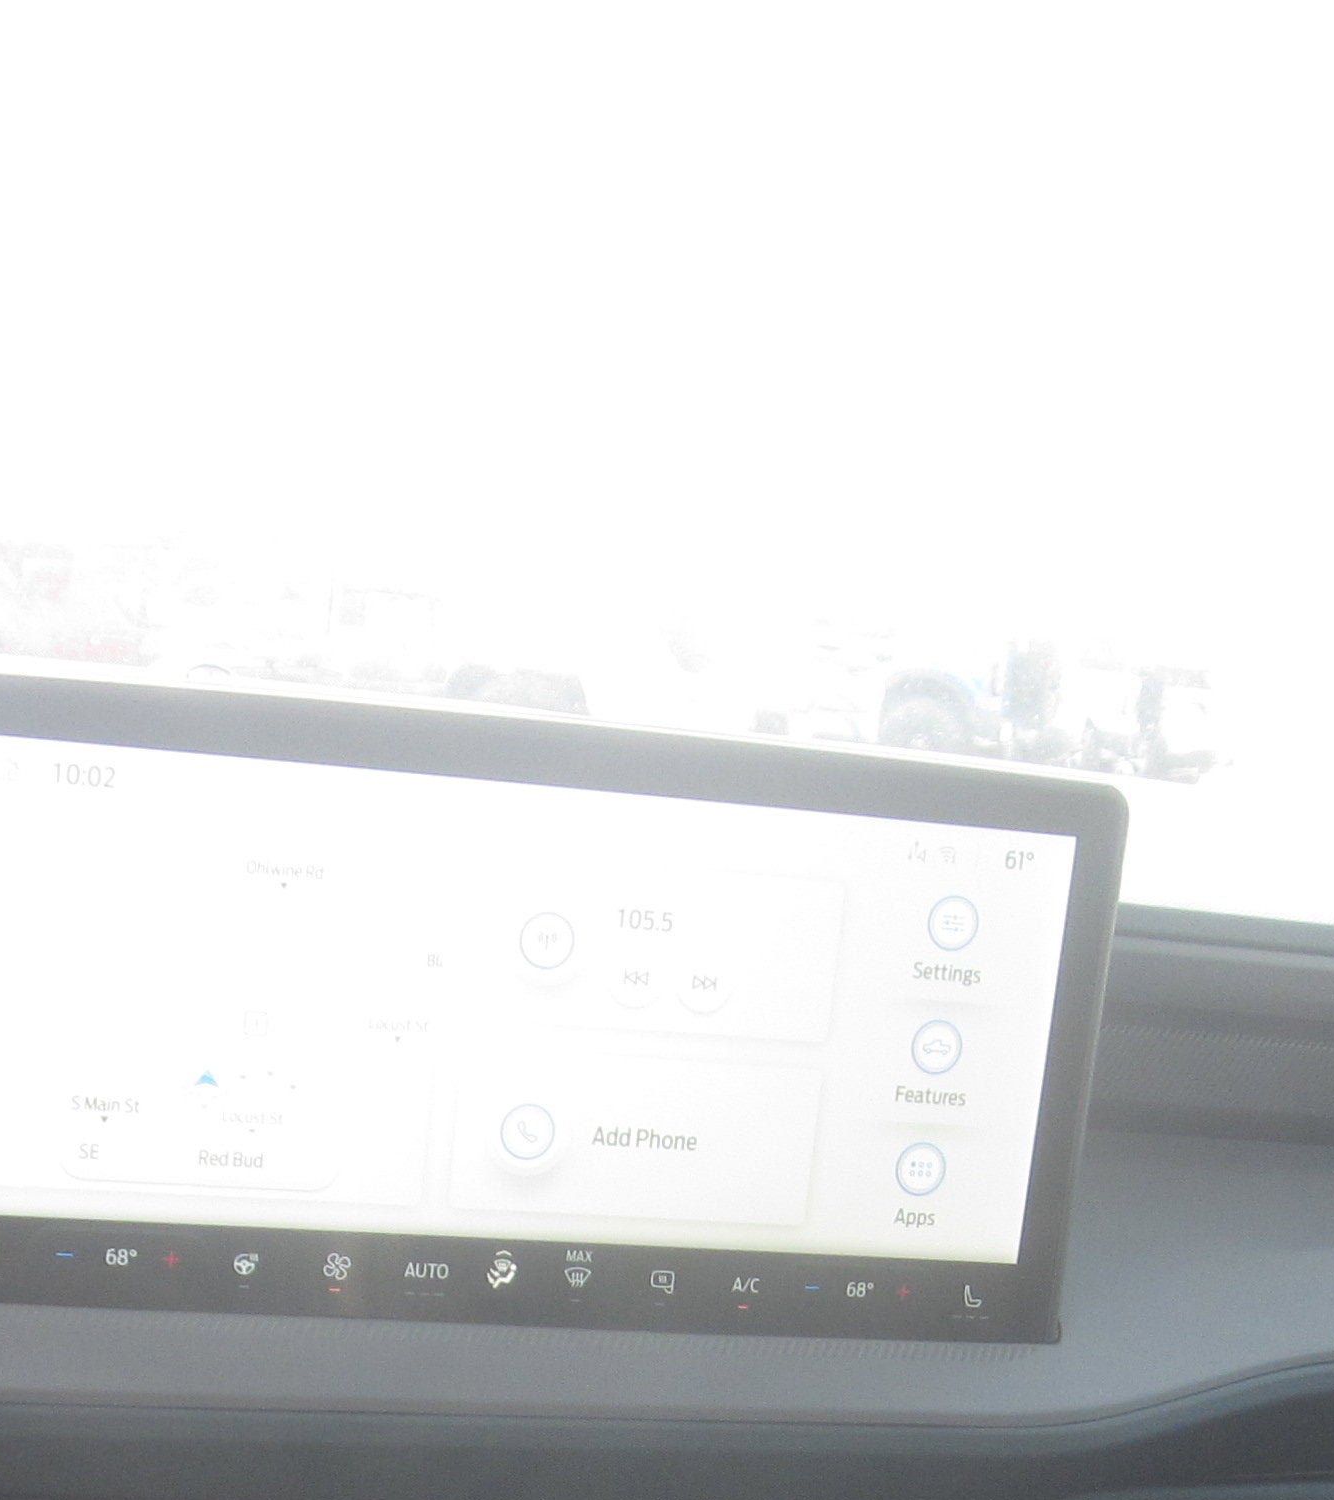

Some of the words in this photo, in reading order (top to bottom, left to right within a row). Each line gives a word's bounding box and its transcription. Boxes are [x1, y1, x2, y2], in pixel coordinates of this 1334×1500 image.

[54, 763, 116, 788] 10:02
[1005, 850, 1034, 870] 61°
[618, 909, 673, 931] 105.5
[912, 961, 981, 986] Settings
[71, 1096, 81, 1110] S
[84, 1097, 120, 1113] Main
[125, 1098, 139, 1113] St
[895, 1085, 966, 1107] Features
[591, 1126, 631, 1147] Add
[636, 1128, 697, 1151] Phone
[79, 1144, 99, 1160] SE
[198, 1150, 228, 1167] Red
[233, 1151, 263, 1168] Bud
[894, 1208, 935, 1228] Apps
[105, 1248, 137, 1266] 68°
[565, 1250, 593, 1263] MAX
[404, 1261, 449, 1280] AUTO
[732, 1277, 760, 1293] A/C
[846, 1281, 874, 1298] 68°
